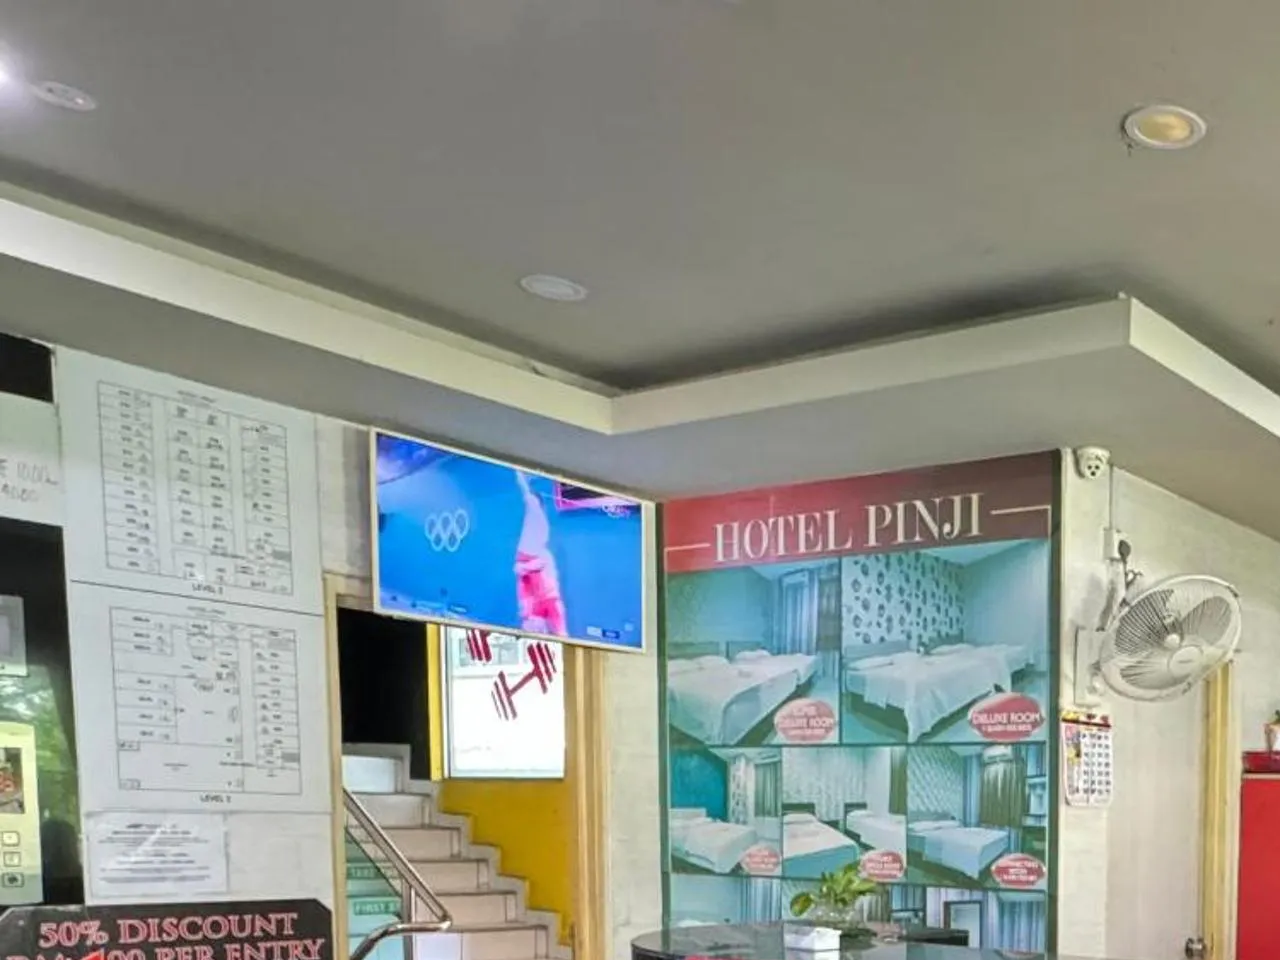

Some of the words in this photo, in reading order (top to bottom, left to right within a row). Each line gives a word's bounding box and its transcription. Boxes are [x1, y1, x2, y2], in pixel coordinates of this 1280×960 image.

[714, 509, 853, 563] HOTEL
[863, 493, 985, 548] PINJI
[39, 920, 109, 948] 50%
[117, 912, 298, 945] DISCOUNT
